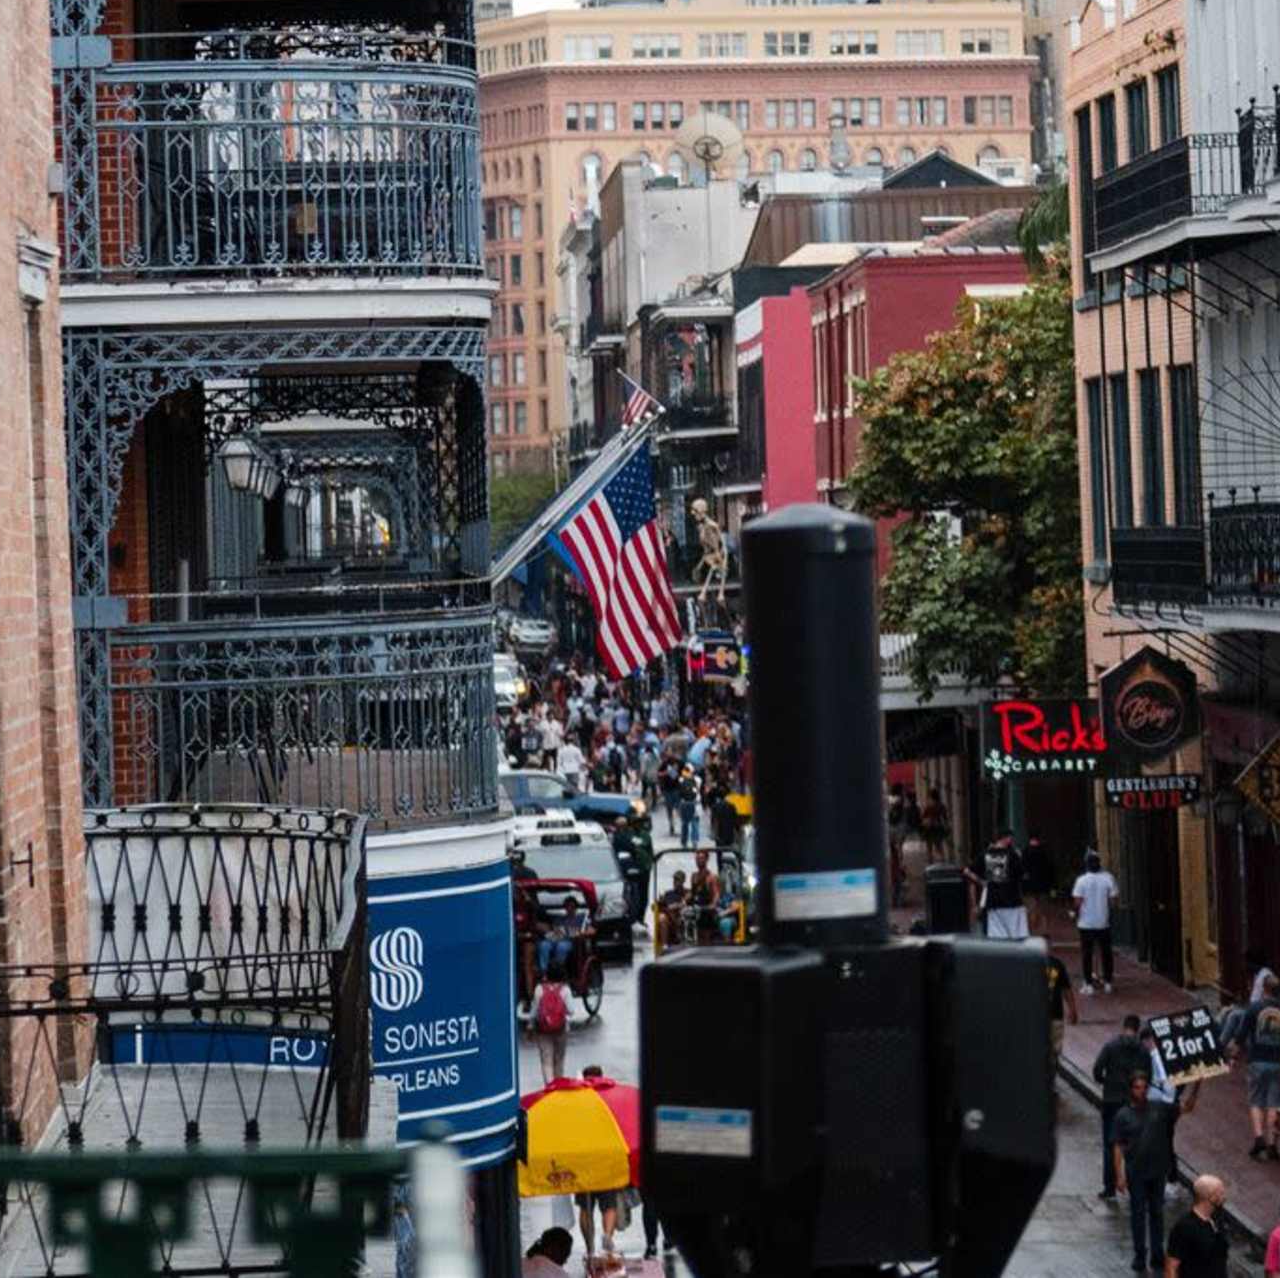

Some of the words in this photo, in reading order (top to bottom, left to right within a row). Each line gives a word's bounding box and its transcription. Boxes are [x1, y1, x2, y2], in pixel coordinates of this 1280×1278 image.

[992, 701, 1108, 754] Rick's
[1011, 758, 1097, 773] CABARET
[1106, 775, 1198, 793] GENTLEMEN'S
[1122, 791, 1182, 809] CLUB
[384, 1015, 479, 1054] SONESTA
[1162, 1039, 1178, 1060] 2
[1177, 1035, 1203, 1057] for
[1203, 1029, 1216, 1049] 1
[376, 1064, 461, 1094] RLEANS
